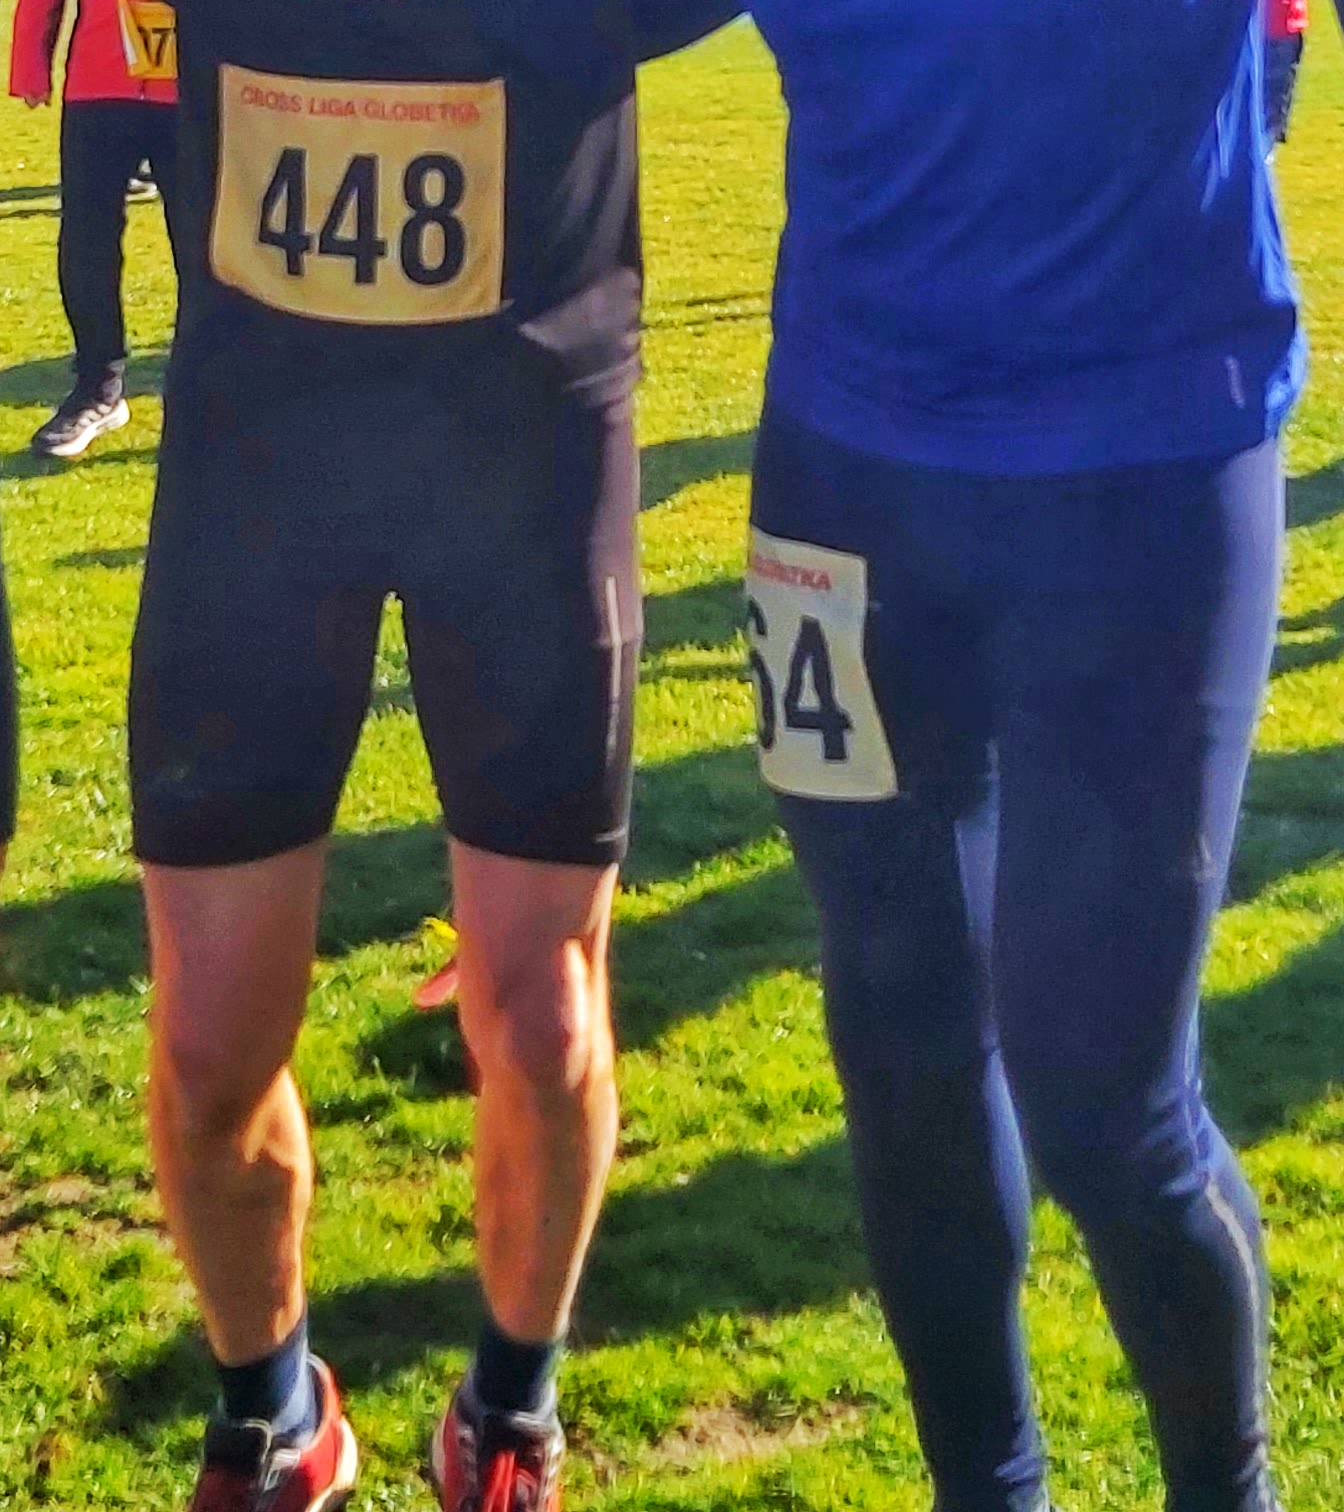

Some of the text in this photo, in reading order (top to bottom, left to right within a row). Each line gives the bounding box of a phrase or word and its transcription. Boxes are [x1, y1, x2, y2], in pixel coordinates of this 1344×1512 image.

[240, 86, 302, 113] CROSS
[309, 96, 356, 117] LIGA
[258, 147, 466, 286] 448
